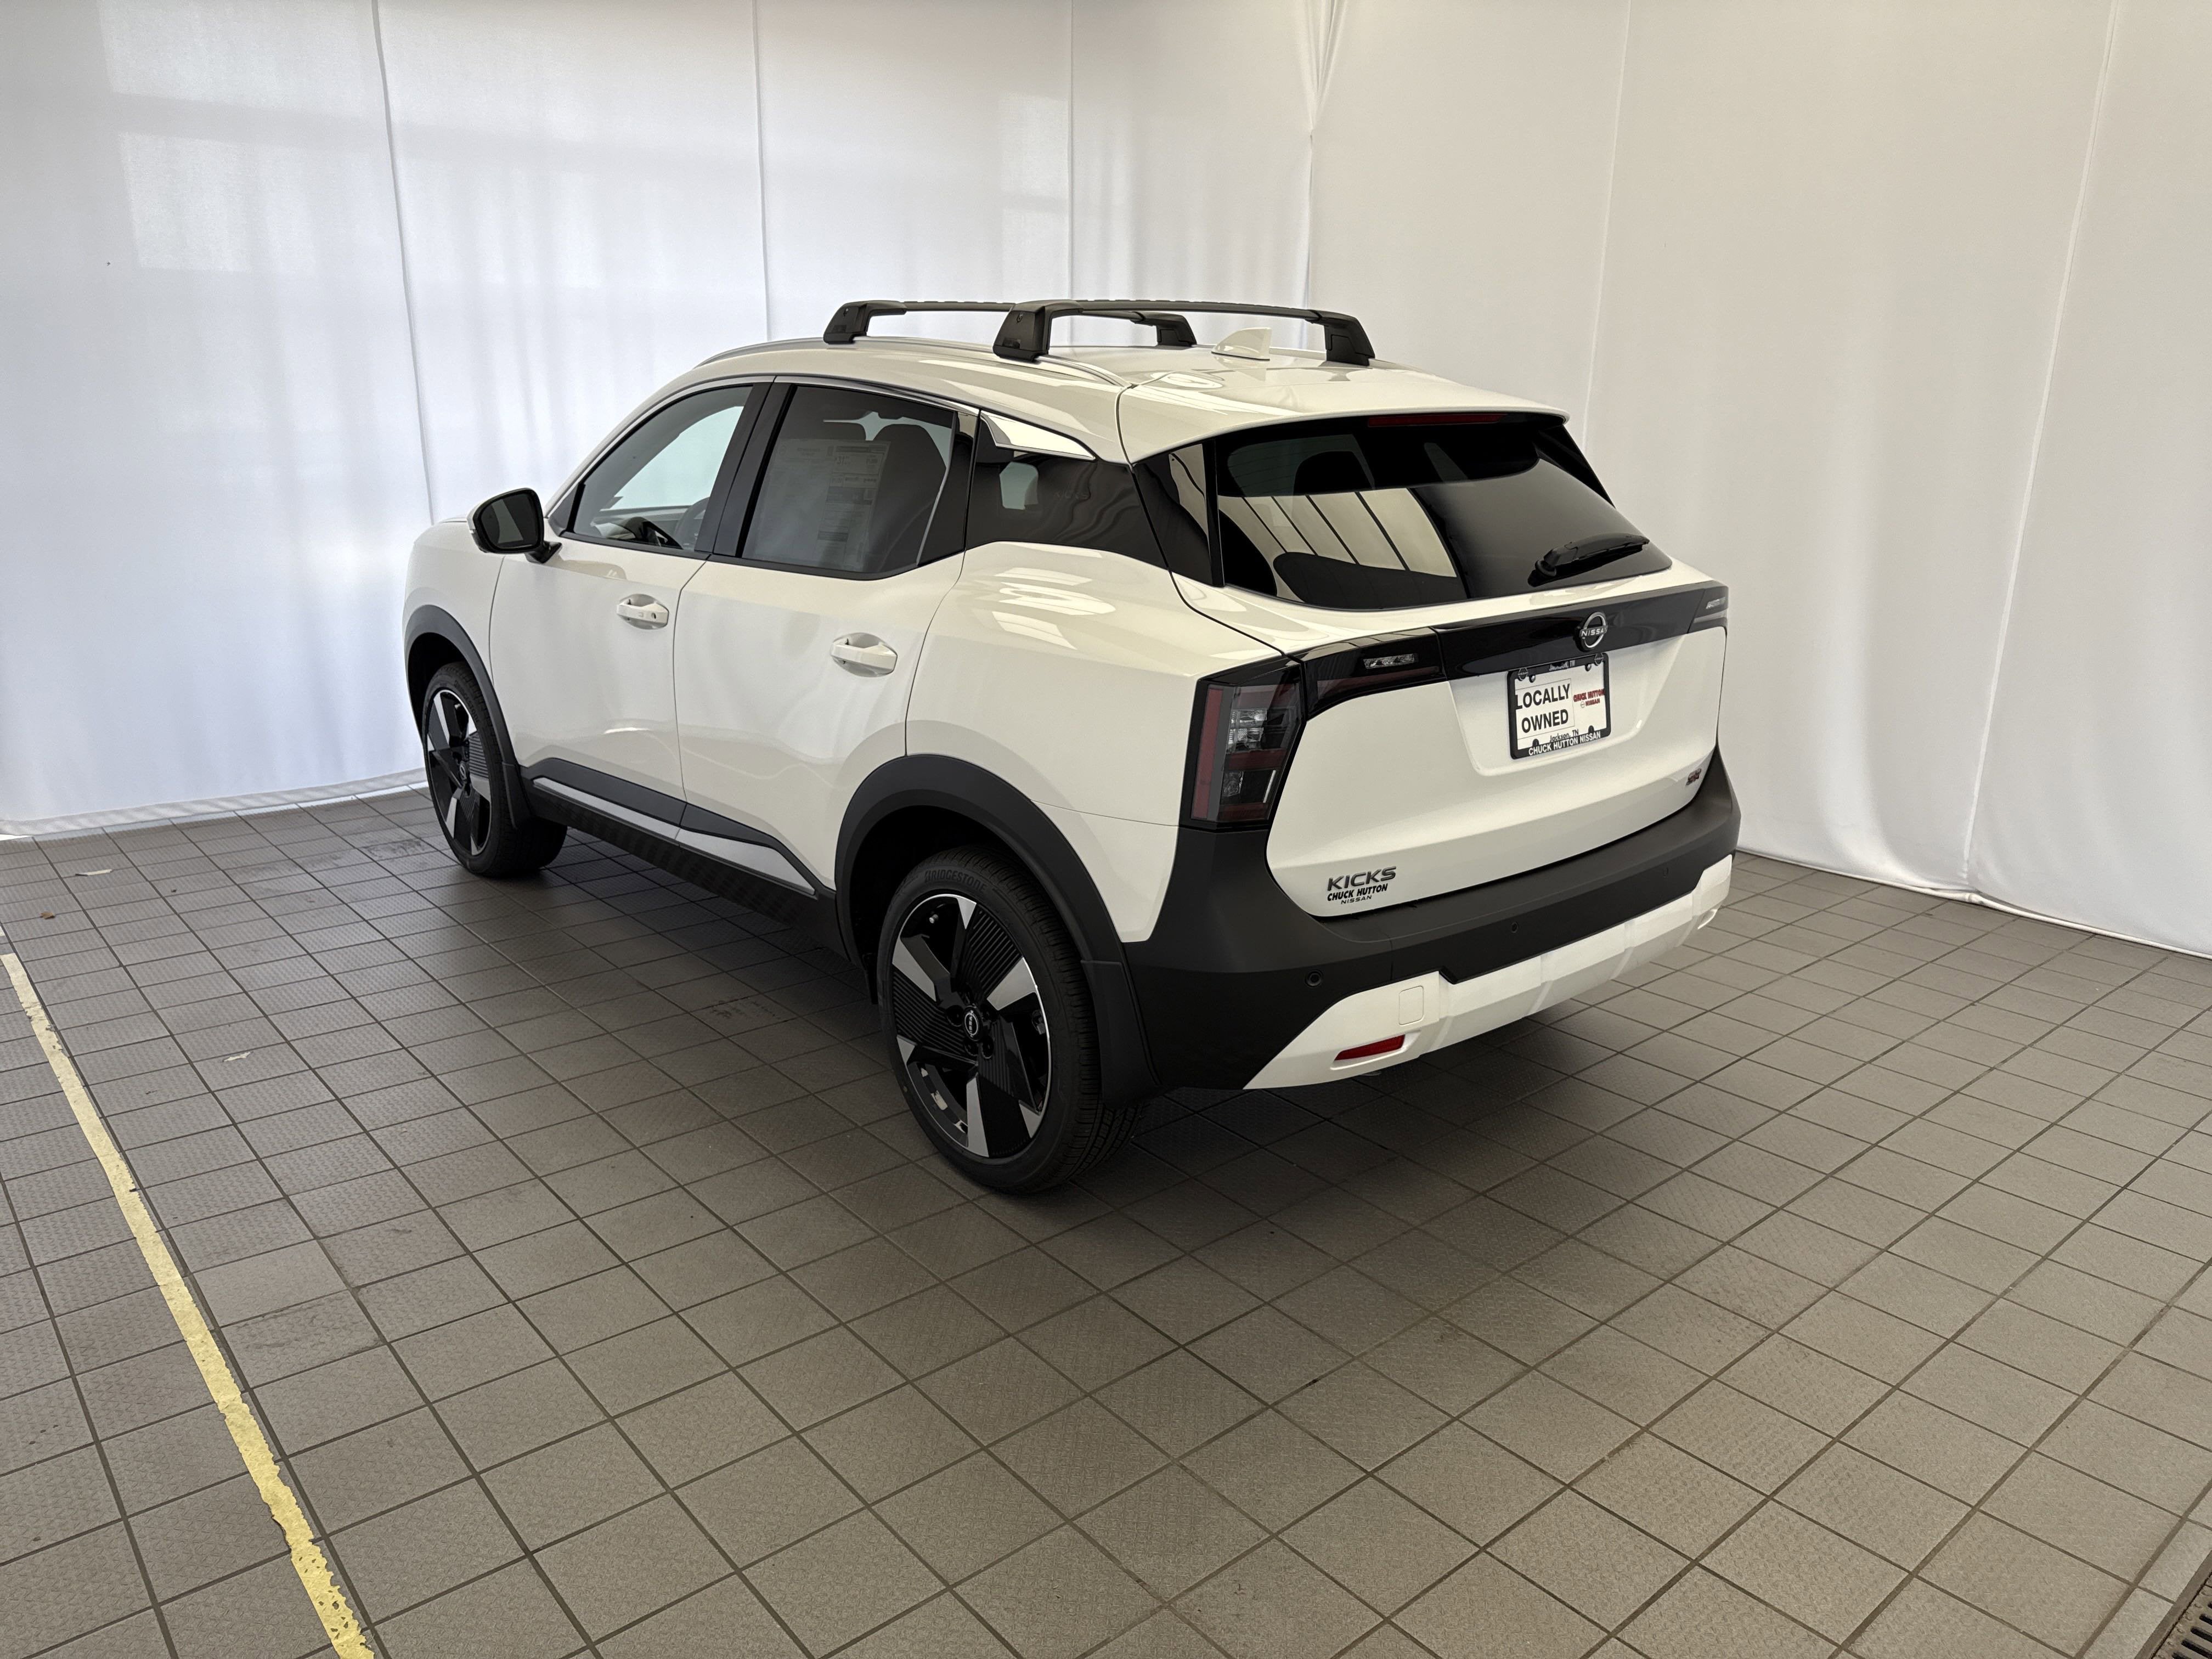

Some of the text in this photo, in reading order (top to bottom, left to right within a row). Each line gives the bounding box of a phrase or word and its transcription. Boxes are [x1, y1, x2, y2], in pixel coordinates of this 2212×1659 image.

[1515, 684, 1570, 709] LOCALLY
[1573, 692, 1587, 702] CHUCK
[1521, 709, 1569, 733] OWNED
[1528, 731, 1601, 756] CHUCK HUTTON NISSAN
[1550, 732, 1571, 742] Jackson,
[924, 868, 989, 893] BRIDGESTONE
[1327, 866, 1397, 891] KICKS
[1327, 883, 1389, 901] CHUCK HUTTON
[1341, 895, 1372, 905] NISSAN
